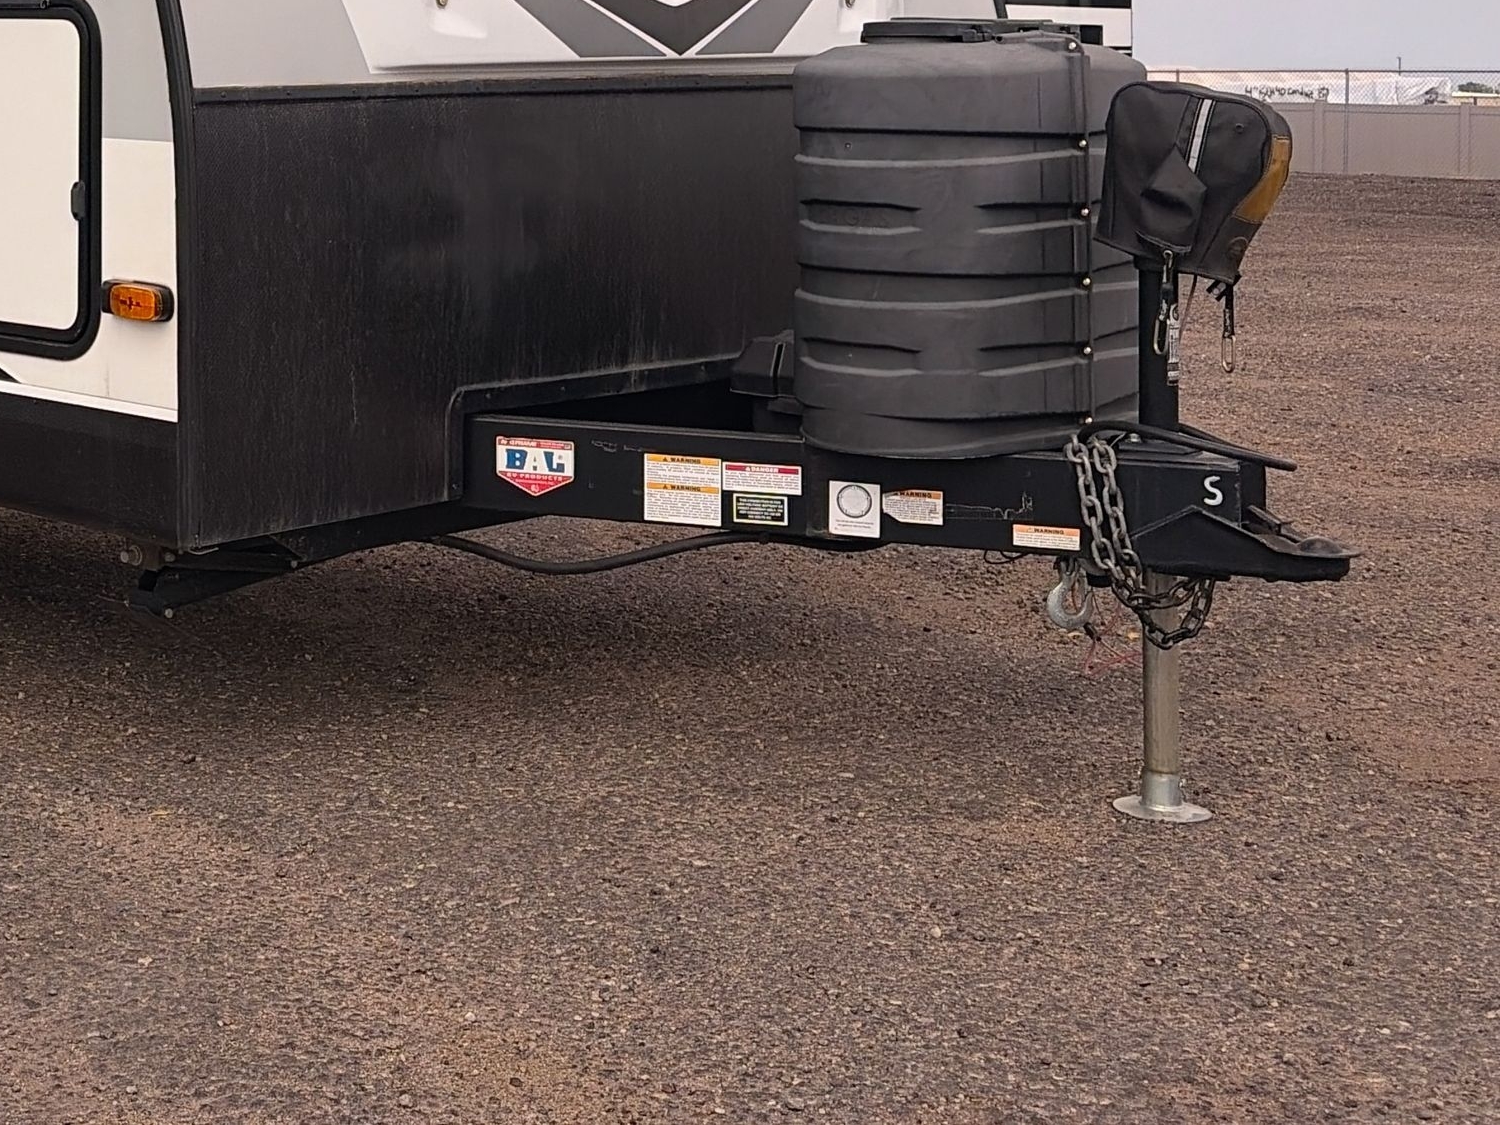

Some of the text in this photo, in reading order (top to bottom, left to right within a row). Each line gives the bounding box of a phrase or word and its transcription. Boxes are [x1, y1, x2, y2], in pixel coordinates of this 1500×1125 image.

[505, 448, 565, 473] BAL
[670, 456, 701, 464] WARNING
[751, 466, 779, 474] DANGER
[669, 484, 701, 492] WARNING
[1203, 475, 1223, 506] S
[1033, 527, 1065, 535] WARNING
